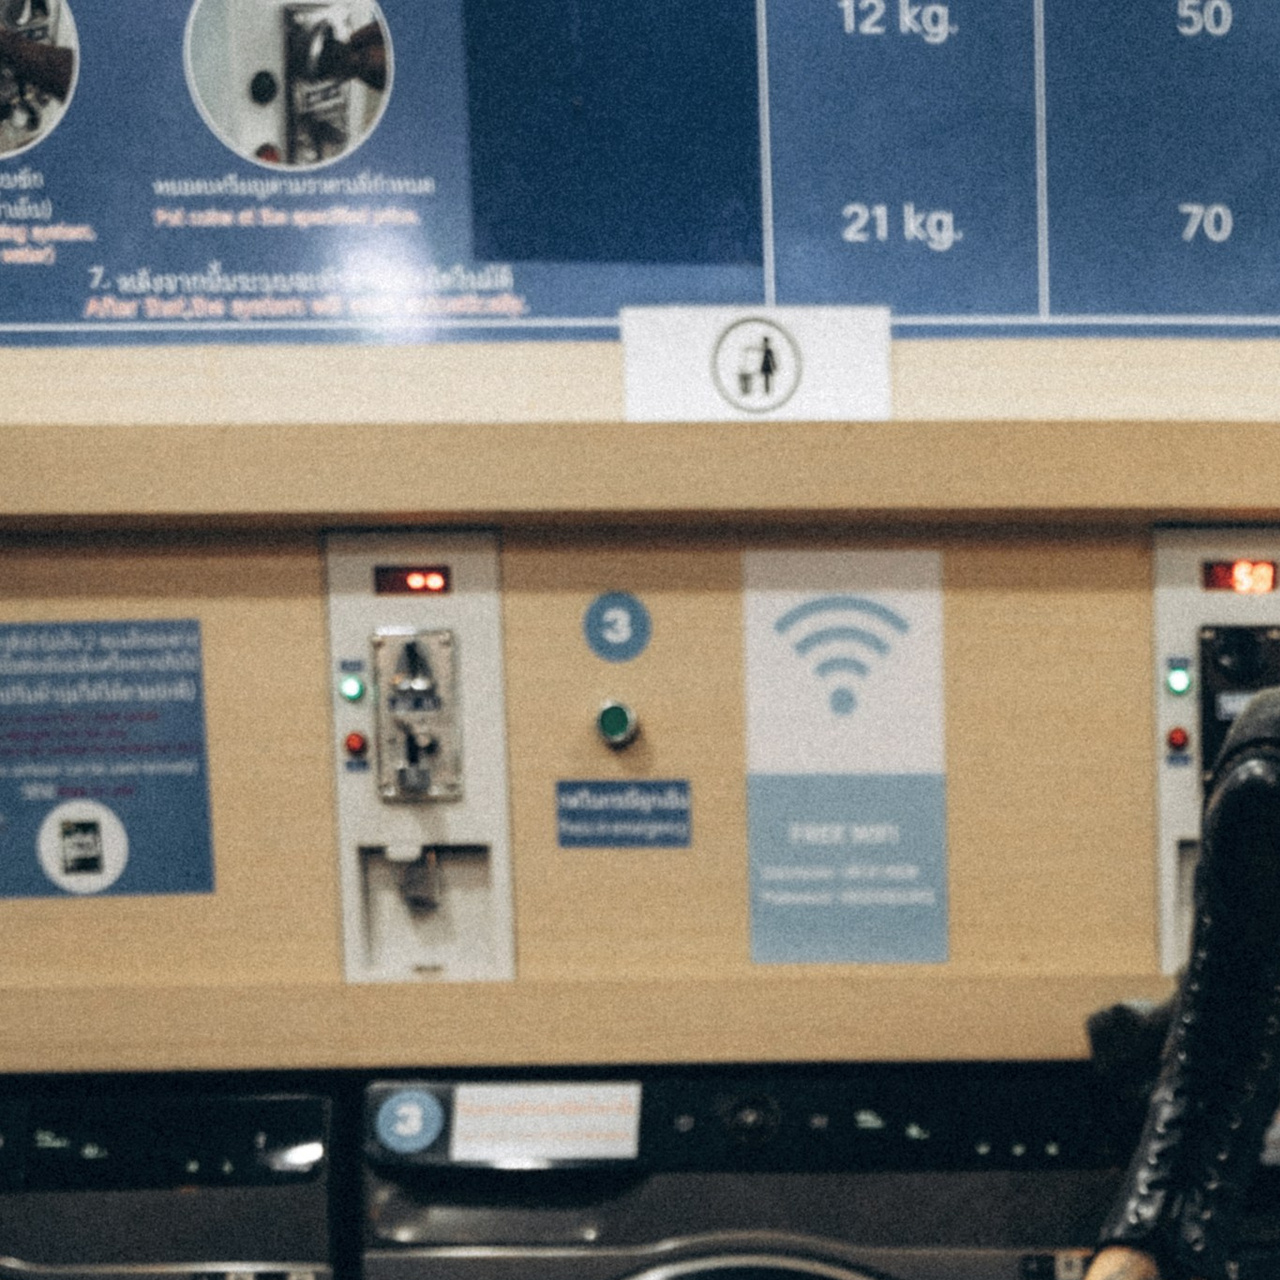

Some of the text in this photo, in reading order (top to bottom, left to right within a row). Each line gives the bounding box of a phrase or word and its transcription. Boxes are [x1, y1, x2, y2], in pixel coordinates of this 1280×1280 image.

[837, 0, 886, 35] 12
[1177, 0, 1233, 36] 50
[841, 202, 963, 253] 21 kg.
[1177, 203, 1233, 243] 70
[602, 606, 633, 644] 3
[395, 1103, 424, 1138] 3
